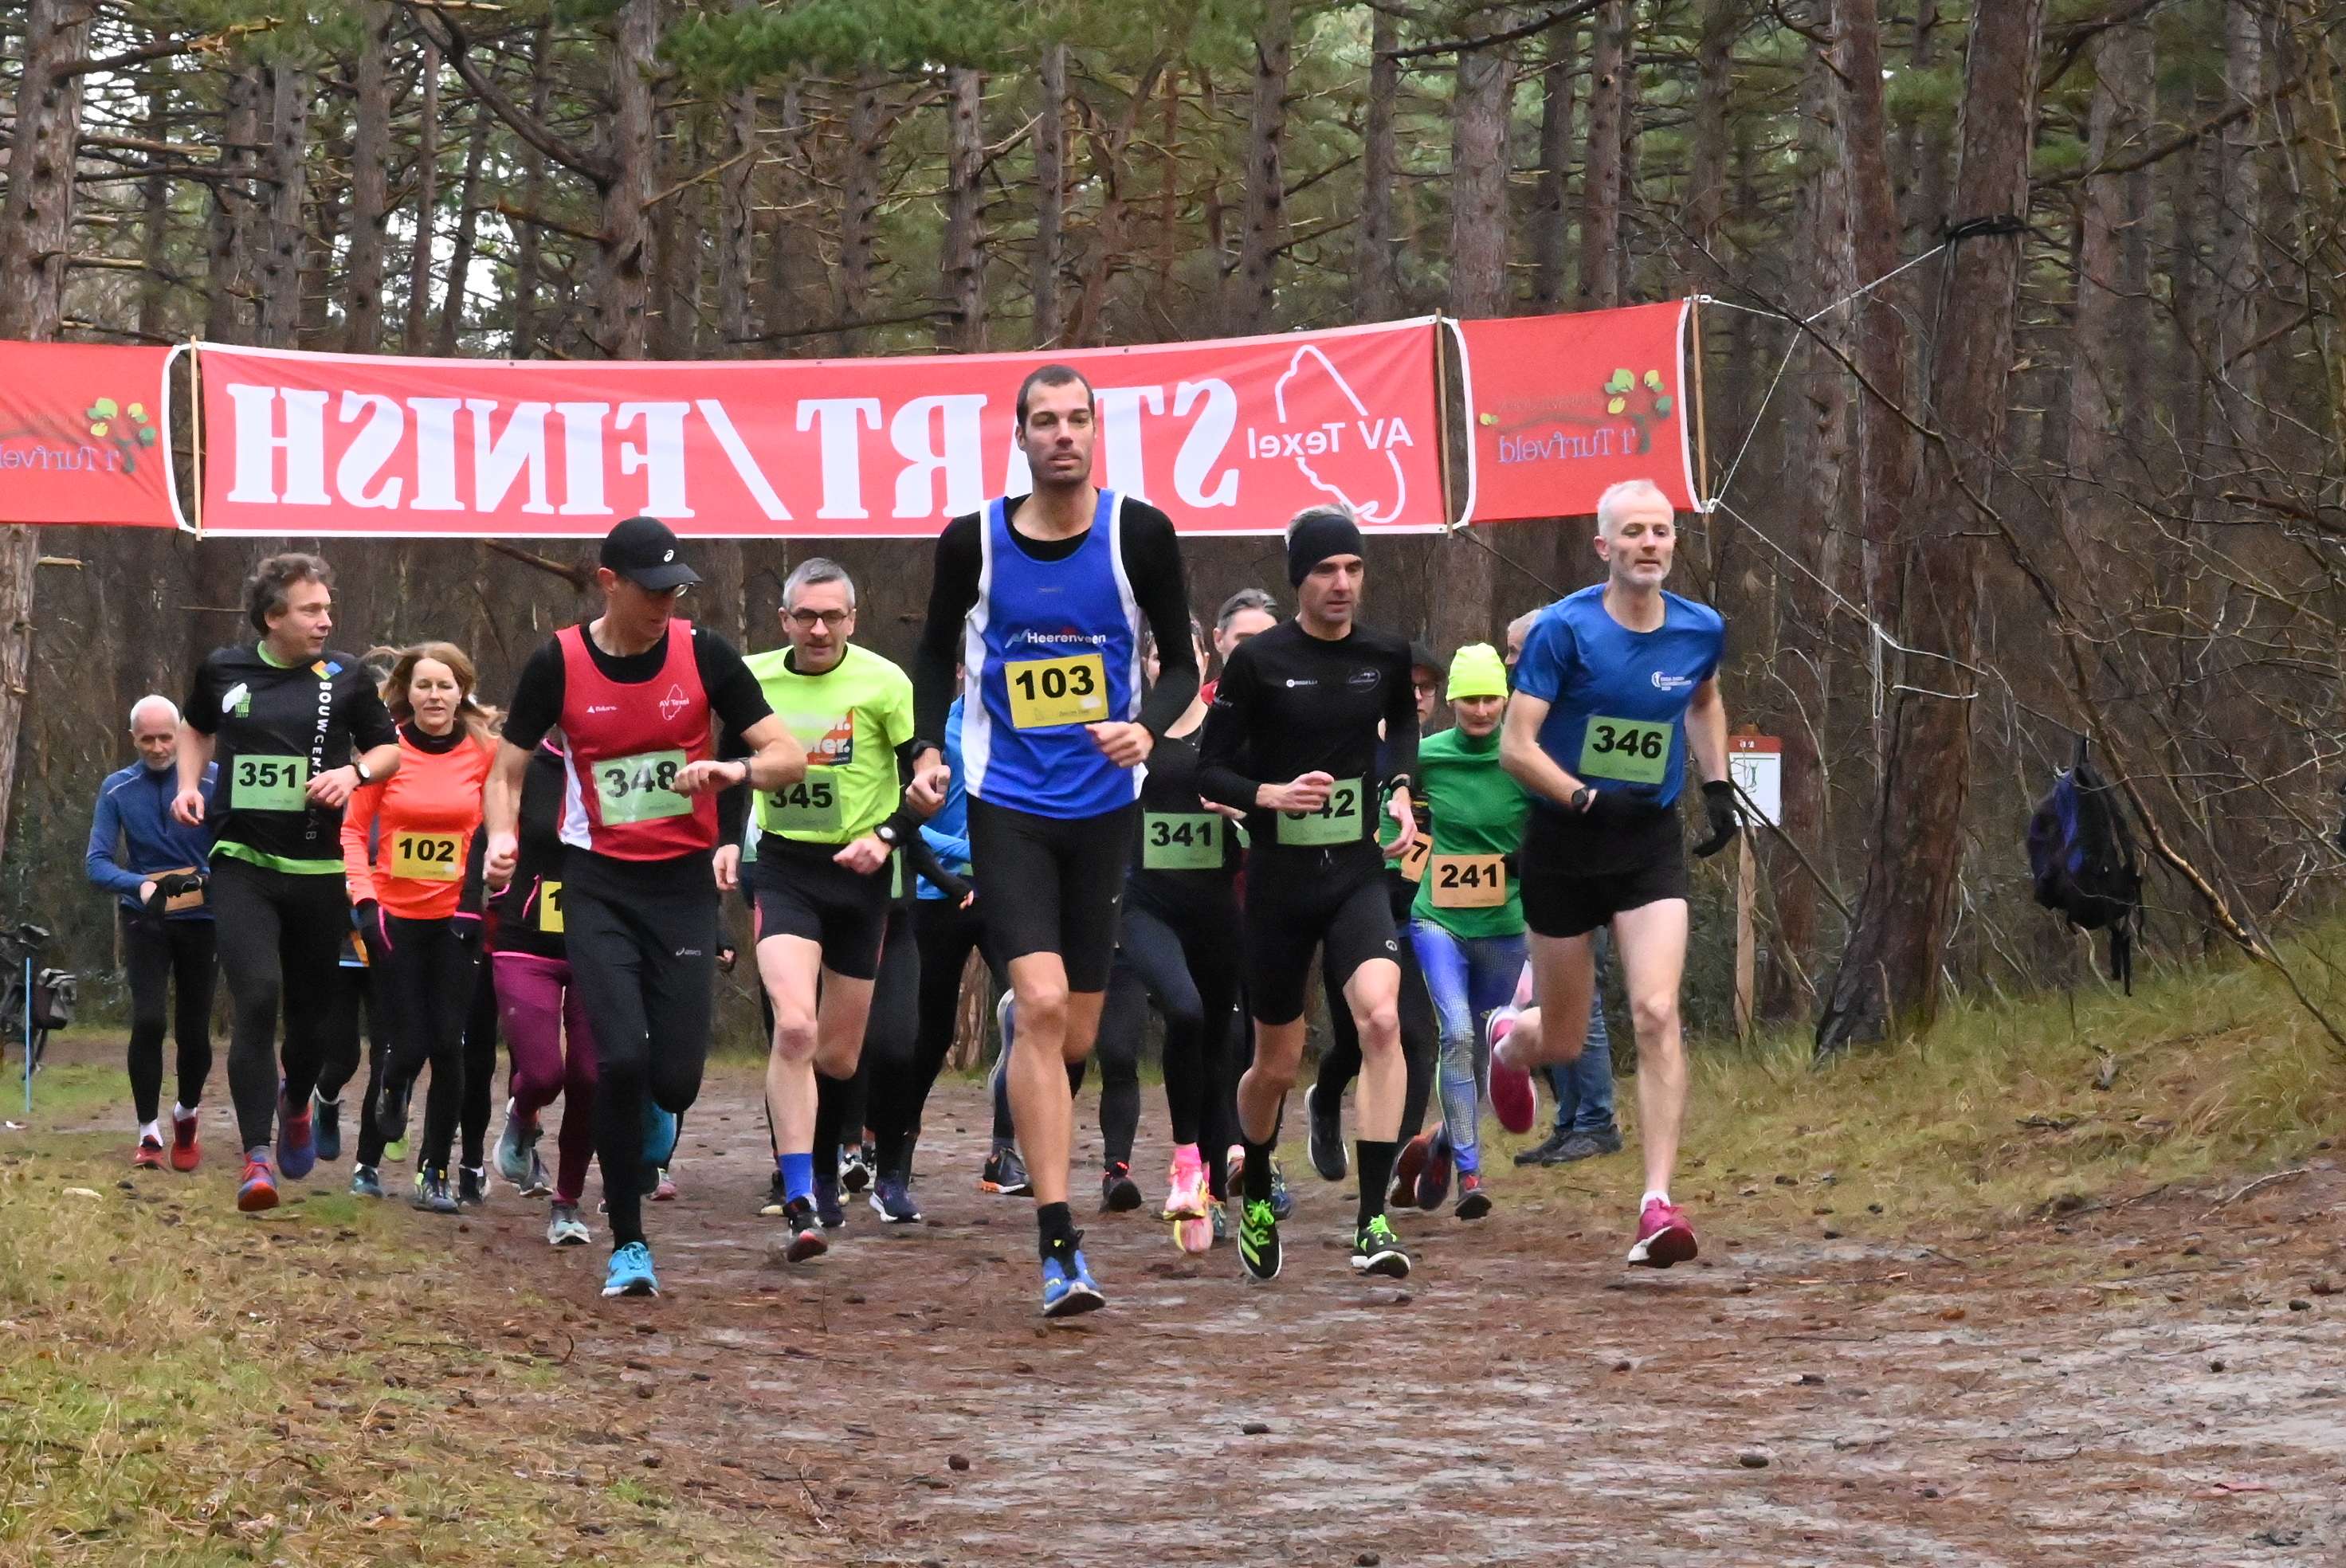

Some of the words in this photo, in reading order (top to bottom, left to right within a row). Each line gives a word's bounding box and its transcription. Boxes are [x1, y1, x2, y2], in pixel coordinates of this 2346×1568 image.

[1027, 631, 1107, 645] Heerenveen
[1015, 664, 1095, 700] 103
[1592, 725, 1663, 759] 346
[238, 762, 296, 789] 351
[605, 760, 677, 798] 348
[769, 782, 833, 809] 345
[1150, 821, 1212, 847] 341
[398, 837, 455, 862] 102
[1440, 864, 1497, 888] 241
